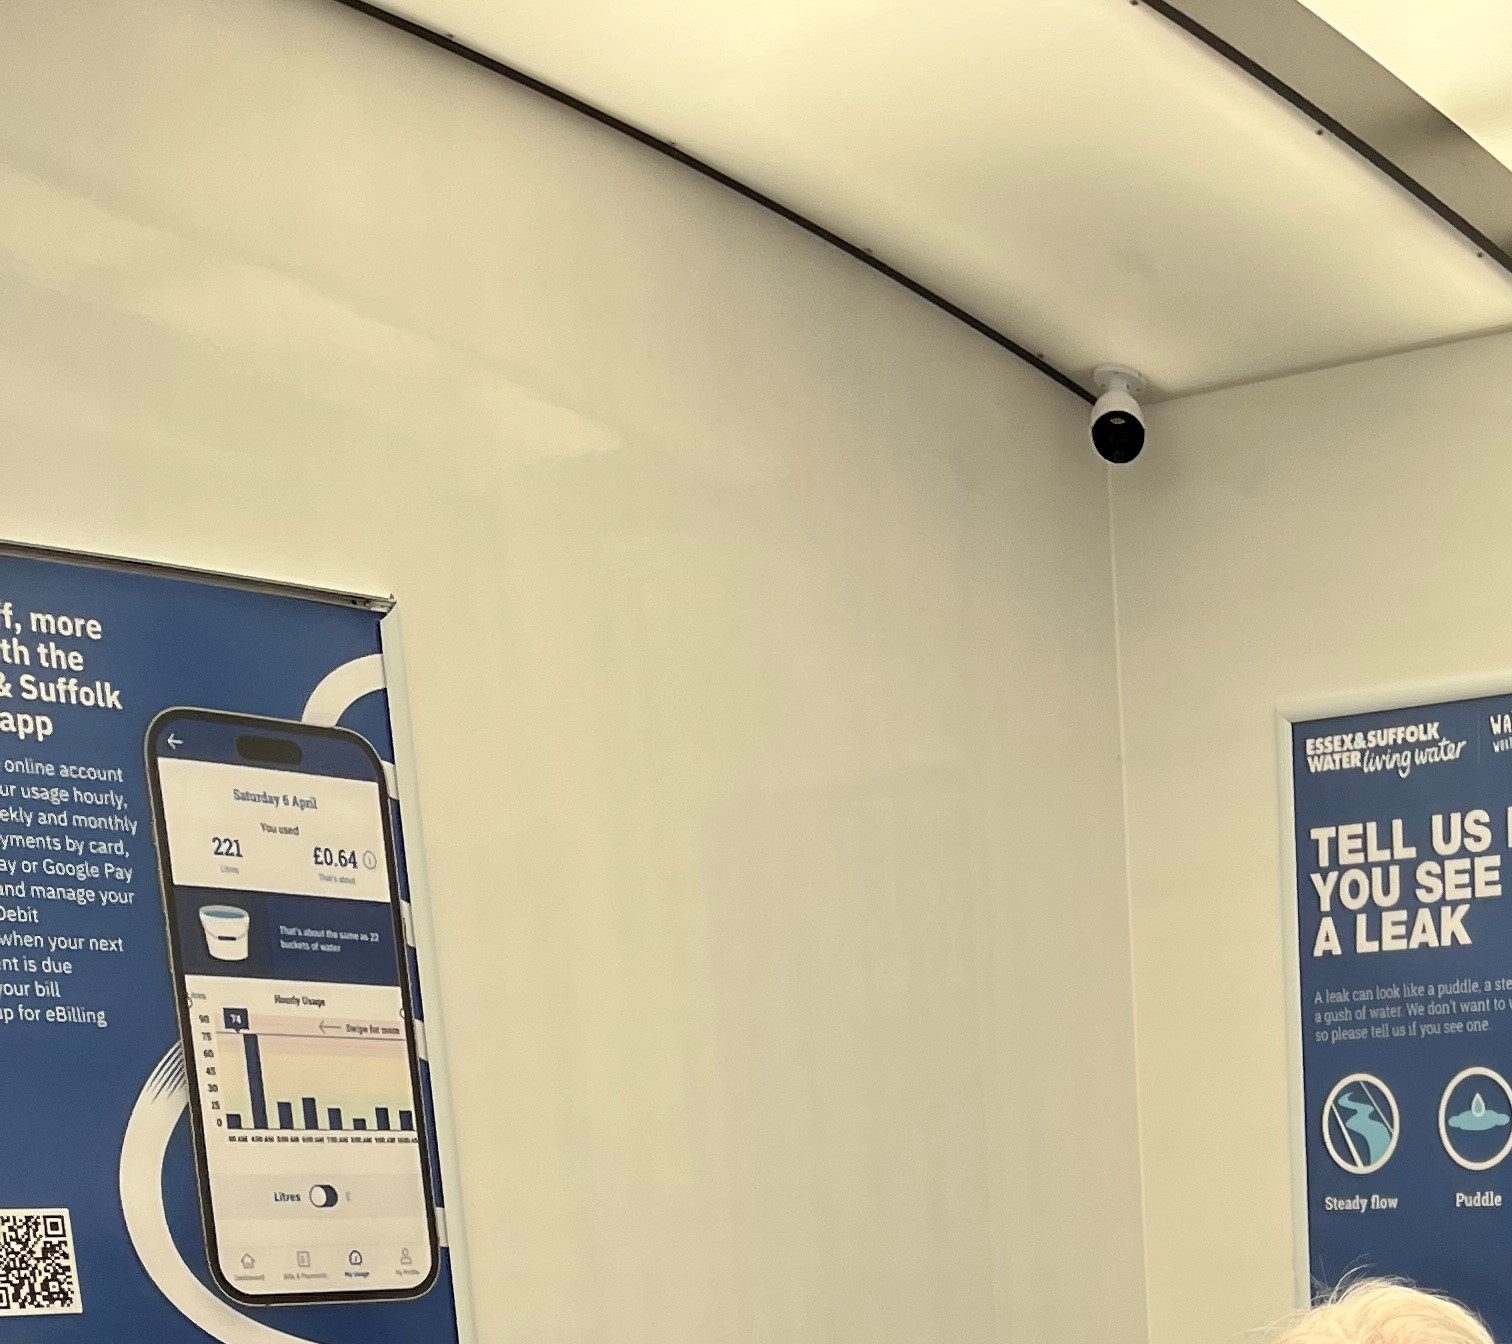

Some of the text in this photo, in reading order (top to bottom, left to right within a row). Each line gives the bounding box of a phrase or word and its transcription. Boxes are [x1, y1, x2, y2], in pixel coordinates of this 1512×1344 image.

[0, 602, 102, 640] f, more
[1, 637, 84, 671] th the
[0, 671, 123, 710] & Suffolk
[0, 711, 53, 742] app
[1305, 721, 1440, 757] ESSEX&SUFFOLK
[5, 757, 123, 782] online account
[1306, 738, 1467, 778] WATER living water
[21, 786, 69, 805] usage
[73, 786, 128, 811] hourly,
[233, 788, 280, 807] Saturday
[292, 795, 318, 810] April
[0, 806, 137, 836] ekly and monthly
[0, 834, 129, 858] yments by card,
[212, 836, 243, 858] 221
[1310, 818, 1416, 868] TELL
[1431, 809, 1492, 857] US
[313, 846, 358, 869] £0.64
[22, 860, 38, 873] or
[43, 858, 100, 881] Google
[104, 862, 133, 884] Pay
[1310, 854, 1502, 912] YOU SEE
[31, 885, 95, 905] manage
[98, 890, 135, 906] your
[0, 930, 124, 952] when your next
[1313, 903, 1472, 957] A LEAK
[23, 955, 73, 974] is due
[0, 980, 61, 999] our bill
[1314, 990, 1323, 1004] A
[1326, 988, 1350, 1003] leak
[1352, 988, 1373, 1001] can
[1376, 983, 1400, 1000] look
[1402, 981, 1424, 997] like
[1427, 984, 1435, 995] a
[1484, 980, 1491, 992] a
[18, 1003, 107, 1028] for eBilling
[1314, 1012, 1321, 1023] a
[1324, 1007, 1352, 1025] gush
[1355, 1005, 1366, 1020] of
[1406, 1002, 1425, 1017] We
[1427, 998, 1456, 1016] don't
[1459, 998, 1490, 1013] want
[1494, 998, 1505, 1011] to
[1315, 1030, 1328, 1042] so
[1331, 1026, 1368, 1044] please
[1370, 1023, 1389, 1038] tell
[1391, 1025, 1406, 1037] us
[1408, 1021, 1417, 1036] if
[1419, 1023, 1440, 1038] you
[1443, 1021, 1464, 1034] see
[1324, 1194, 1399, 1214] Steady flow
[1455, 1191, 1503, 1208] Puddle
